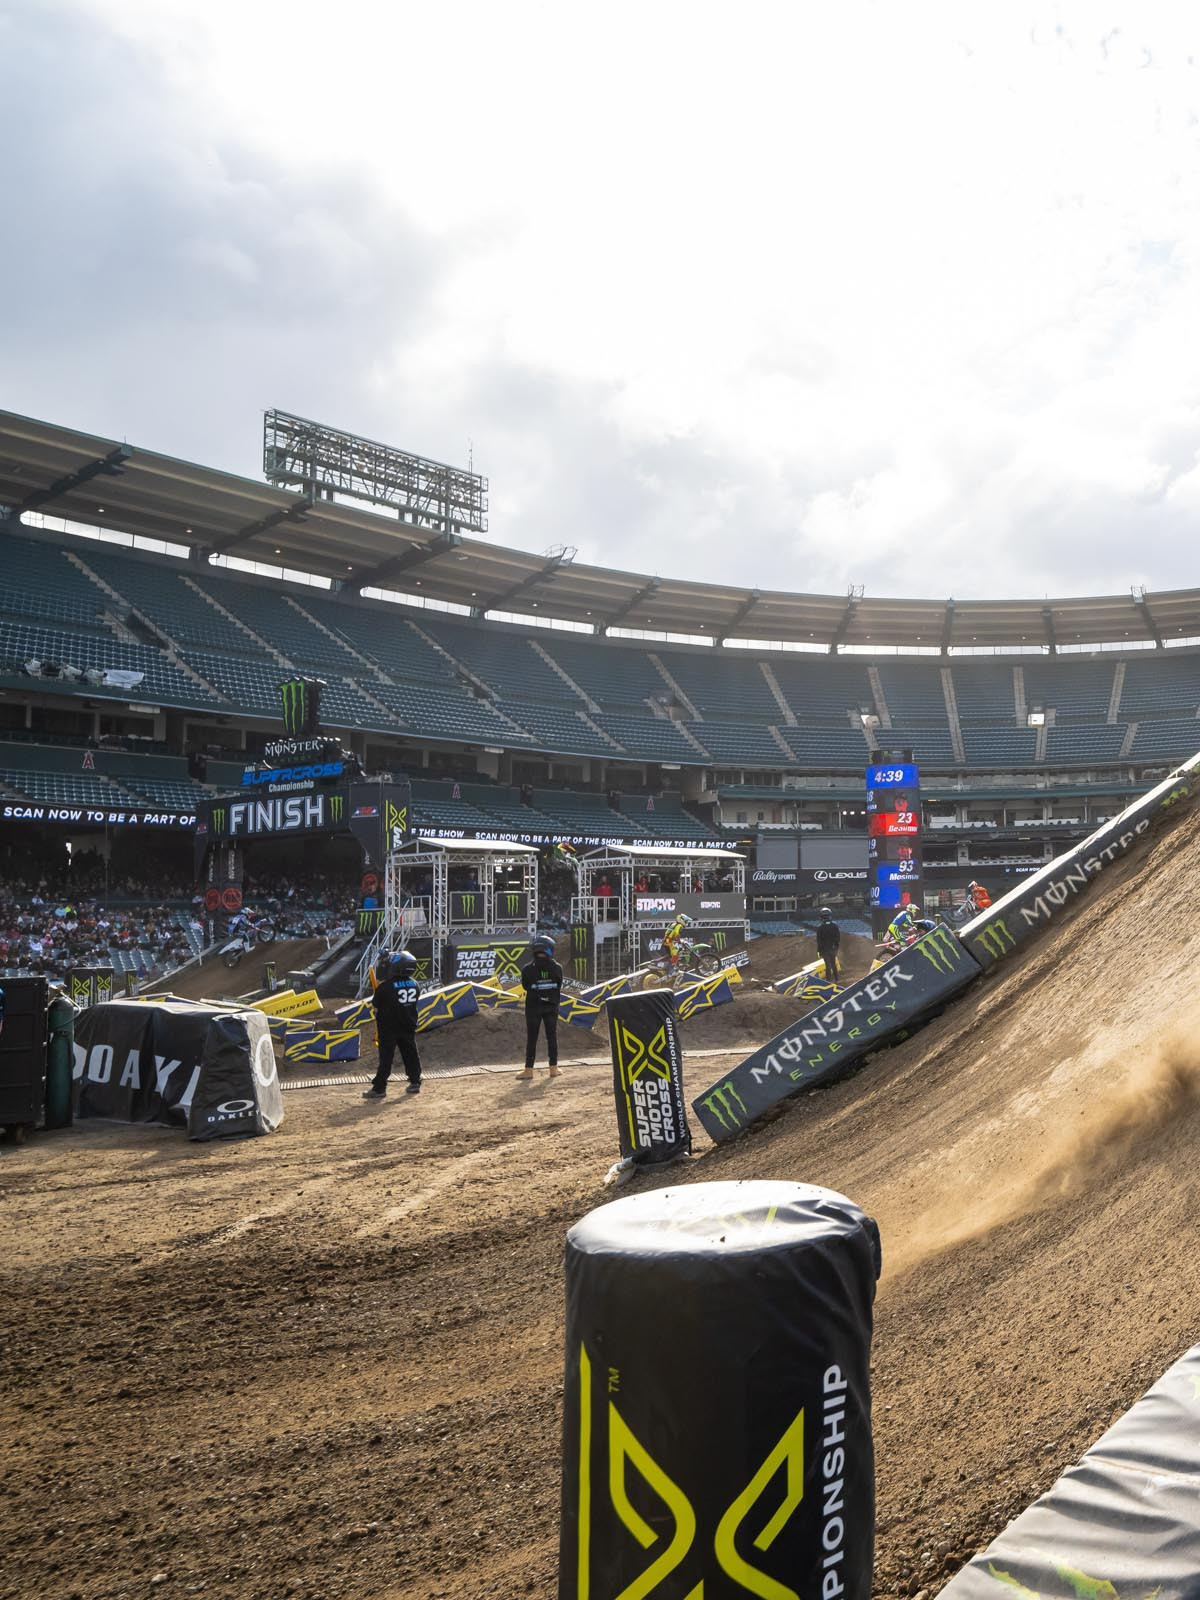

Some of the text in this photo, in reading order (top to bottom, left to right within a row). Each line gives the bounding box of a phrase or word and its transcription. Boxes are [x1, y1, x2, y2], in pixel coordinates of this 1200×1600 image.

[241, 761, 345, 786] SUPERCROSS
[874, 769, 904, 783] 4:39
[268, 780, 315, 793] Championship
[3, 806, 197, 826] SCAN NOW TO BE A PART OF
[230, 794, 325, 836] FINISH
[897, 812, 913, 824] 23
[418, 828, 437, 838] THE
[438, 829, 465, 839] SHOW
[475, 831, 624, 847] SCAN NOW TO BE A PART OF THE SHOW
[632, 839, 737, 850] SCAN NOW TO BE A PART OF
[898, 860, 914, 872] 93
[752, 870, 778, 883] Bally
[636, 898, 676, 911] STACYC
[456, 950, 497, 961] SUPER
[459, 960, 495, 969] MOTO
[456, 968, 496, 978] CROSS
[397, 988, 417, 1003] 32
[275, 997, 315, 1015] DUNLOP
[749, 964, 914, 1085] MONSTER
[789, 1000, 897, 1081] ENERGY
[665, 1017, 685, 1139] WORLD CHAMPIONSHIP
[633, 1079, 652, 1148] SUPER
[645, 1080, 664, 1141] MOTO
[657, 1078, 675, 1144] CROSS
[822, 1363, 848, 1600] PIONSHIP
